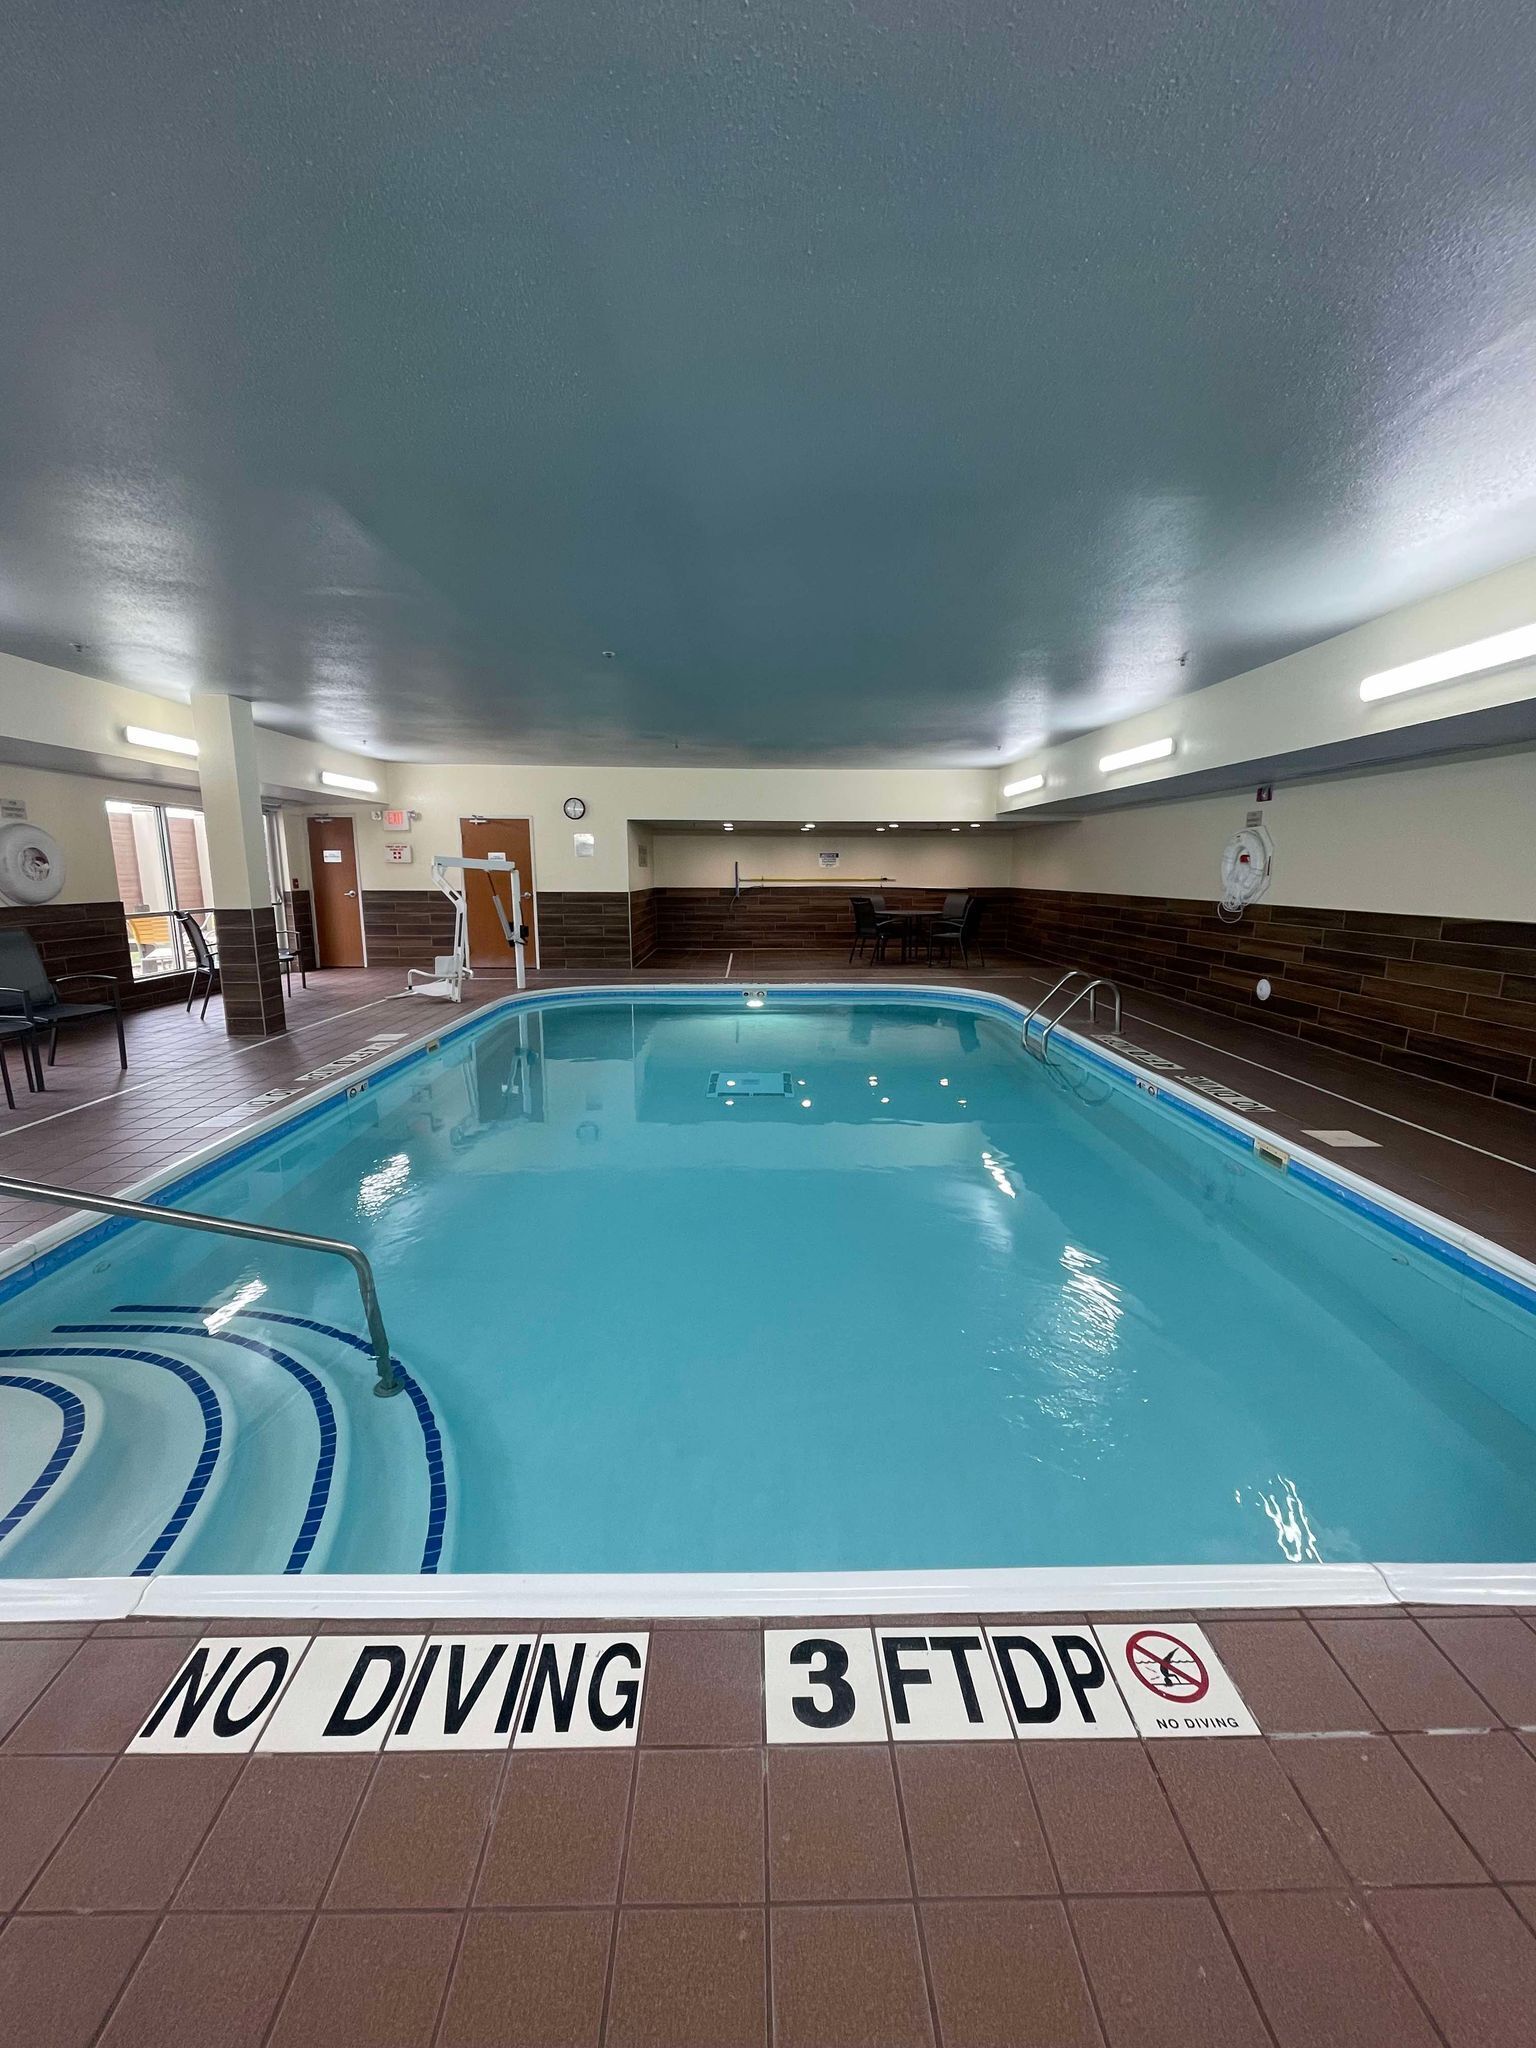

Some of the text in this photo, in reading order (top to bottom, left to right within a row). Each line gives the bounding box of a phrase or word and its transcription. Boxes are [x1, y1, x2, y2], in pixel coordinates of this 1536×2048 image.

[140, 1642, 642, 1738] NO DIVING
[788, 1638, 856, 1728] 3
[1155, 1717, 1239, 1729] NO DIVING
